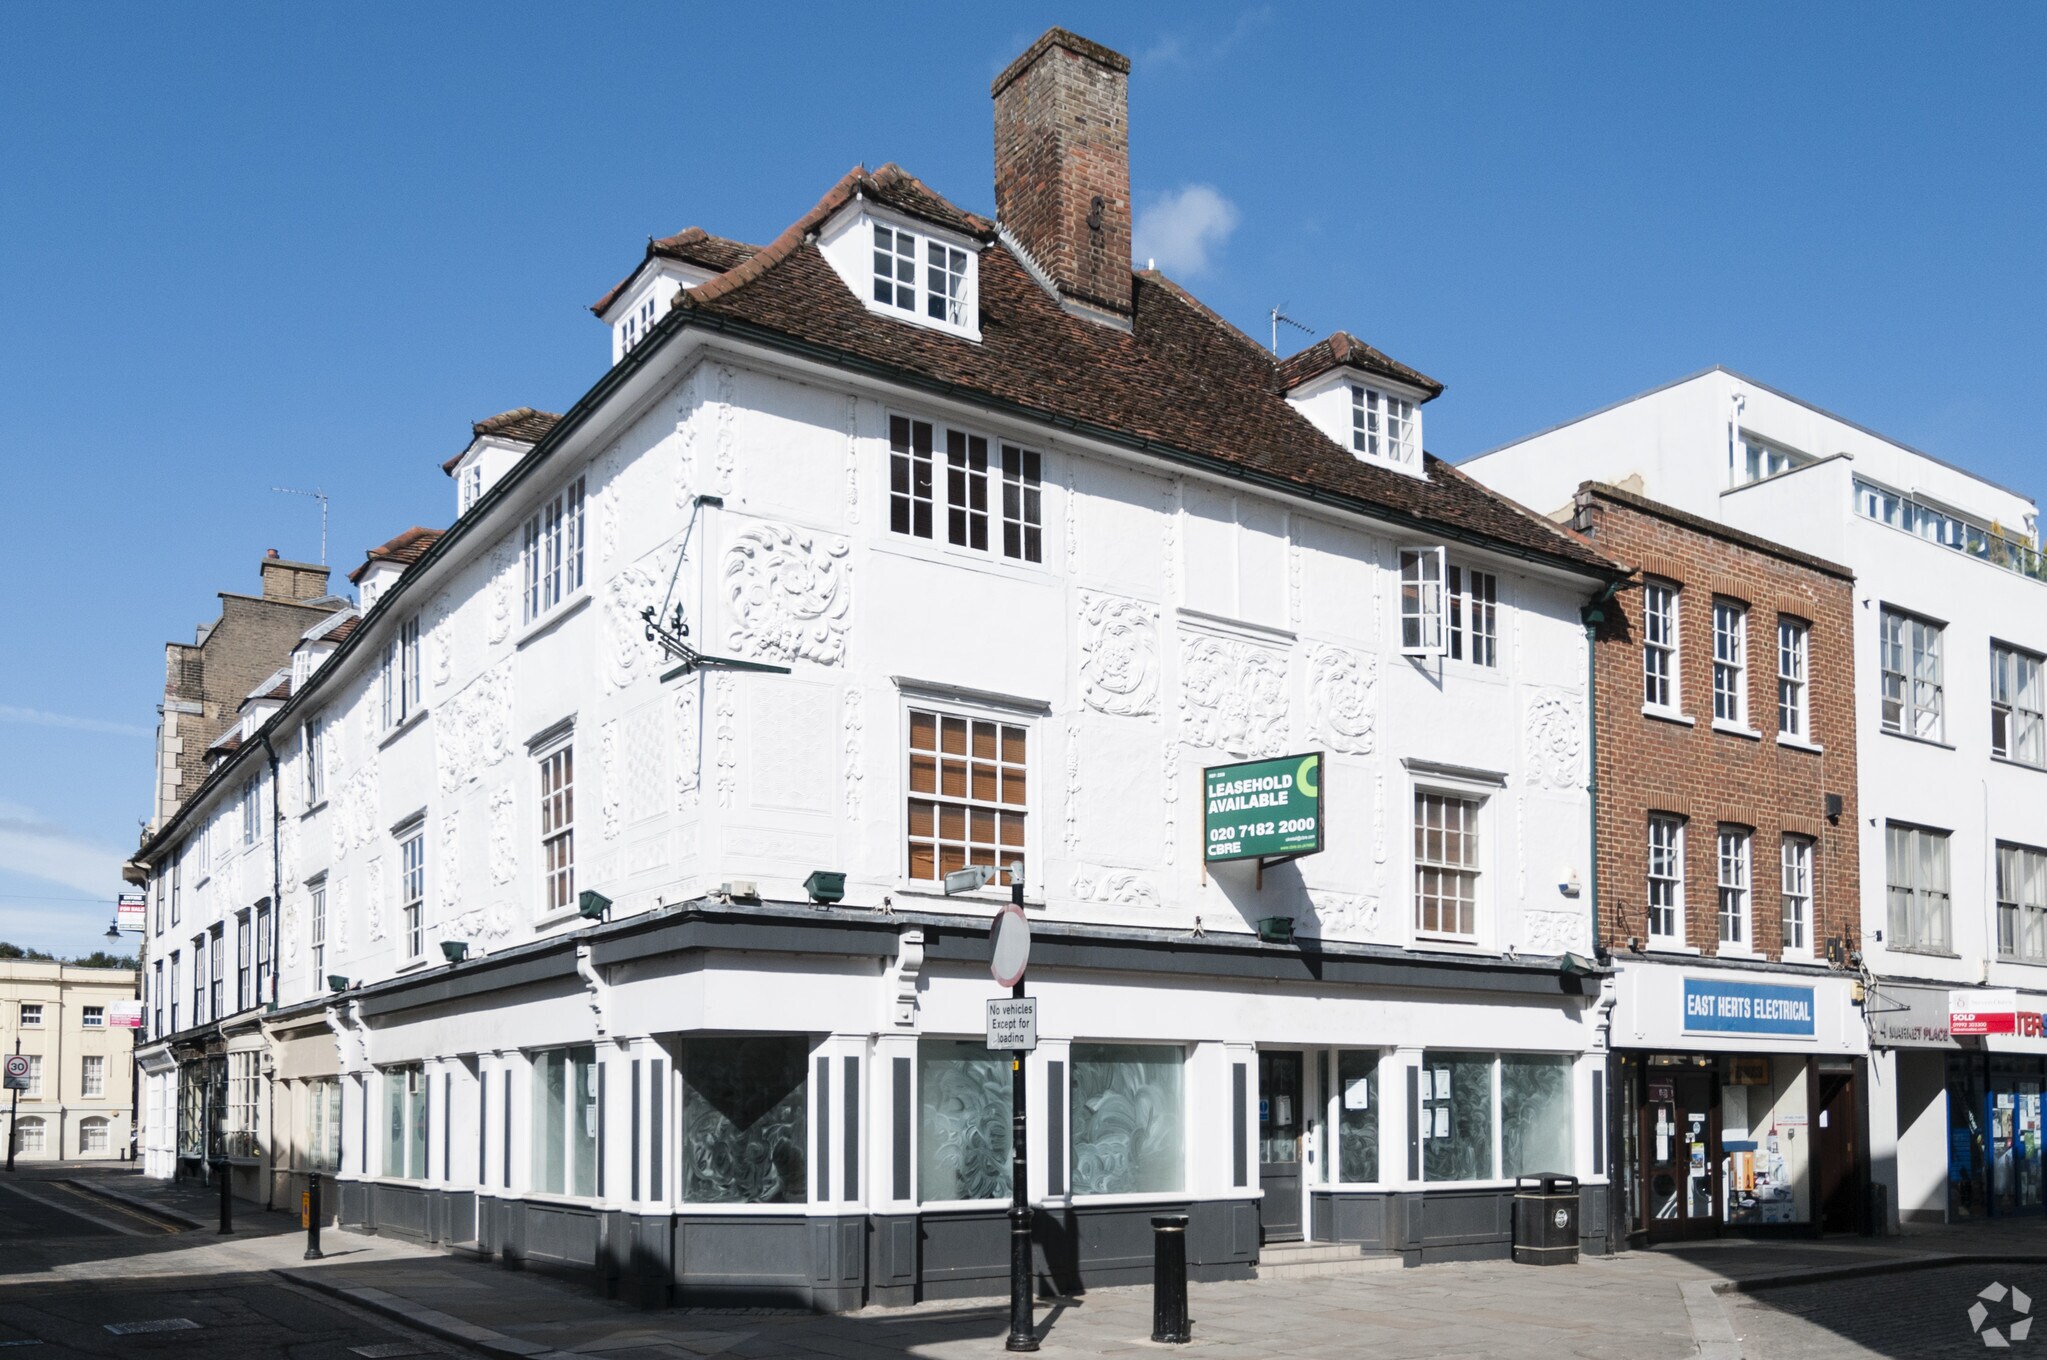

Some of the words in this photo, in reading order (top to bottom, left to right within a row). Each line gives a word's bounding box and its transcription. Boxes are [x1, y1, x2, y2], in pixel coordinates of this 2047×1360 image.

[1208, 774, 1293, 798] LEASEHOLD
[1208, 791, 1289, 814] AVAILABLE
[1209, 827, 1235, 842] 020
[1238, 822, 1275, 838] 7182
[1278, 817, 1315, 834] 2000
[1207, 841, 1242, 856] CBRE
[989, 1005, 1000, 1015] No
[1002, 1004, 1033, 1015] vehicles
[1687, 994, 1715, 1016] EAST
[1717, 996, 1751, 1018] HERTS
[1753, 998, 1811, 1021] ELECTRICAL
[992, 1018, 1017, 1030] Except
[1018, 1017, 1030, 1029] for
[997, 1032, 1024, 1043] loading
[1889, 1026, 1922, 1040] MARKET
[1923, 1026, 1949, 1041] PLACE
[10, 1062, 24, 1071] 30
